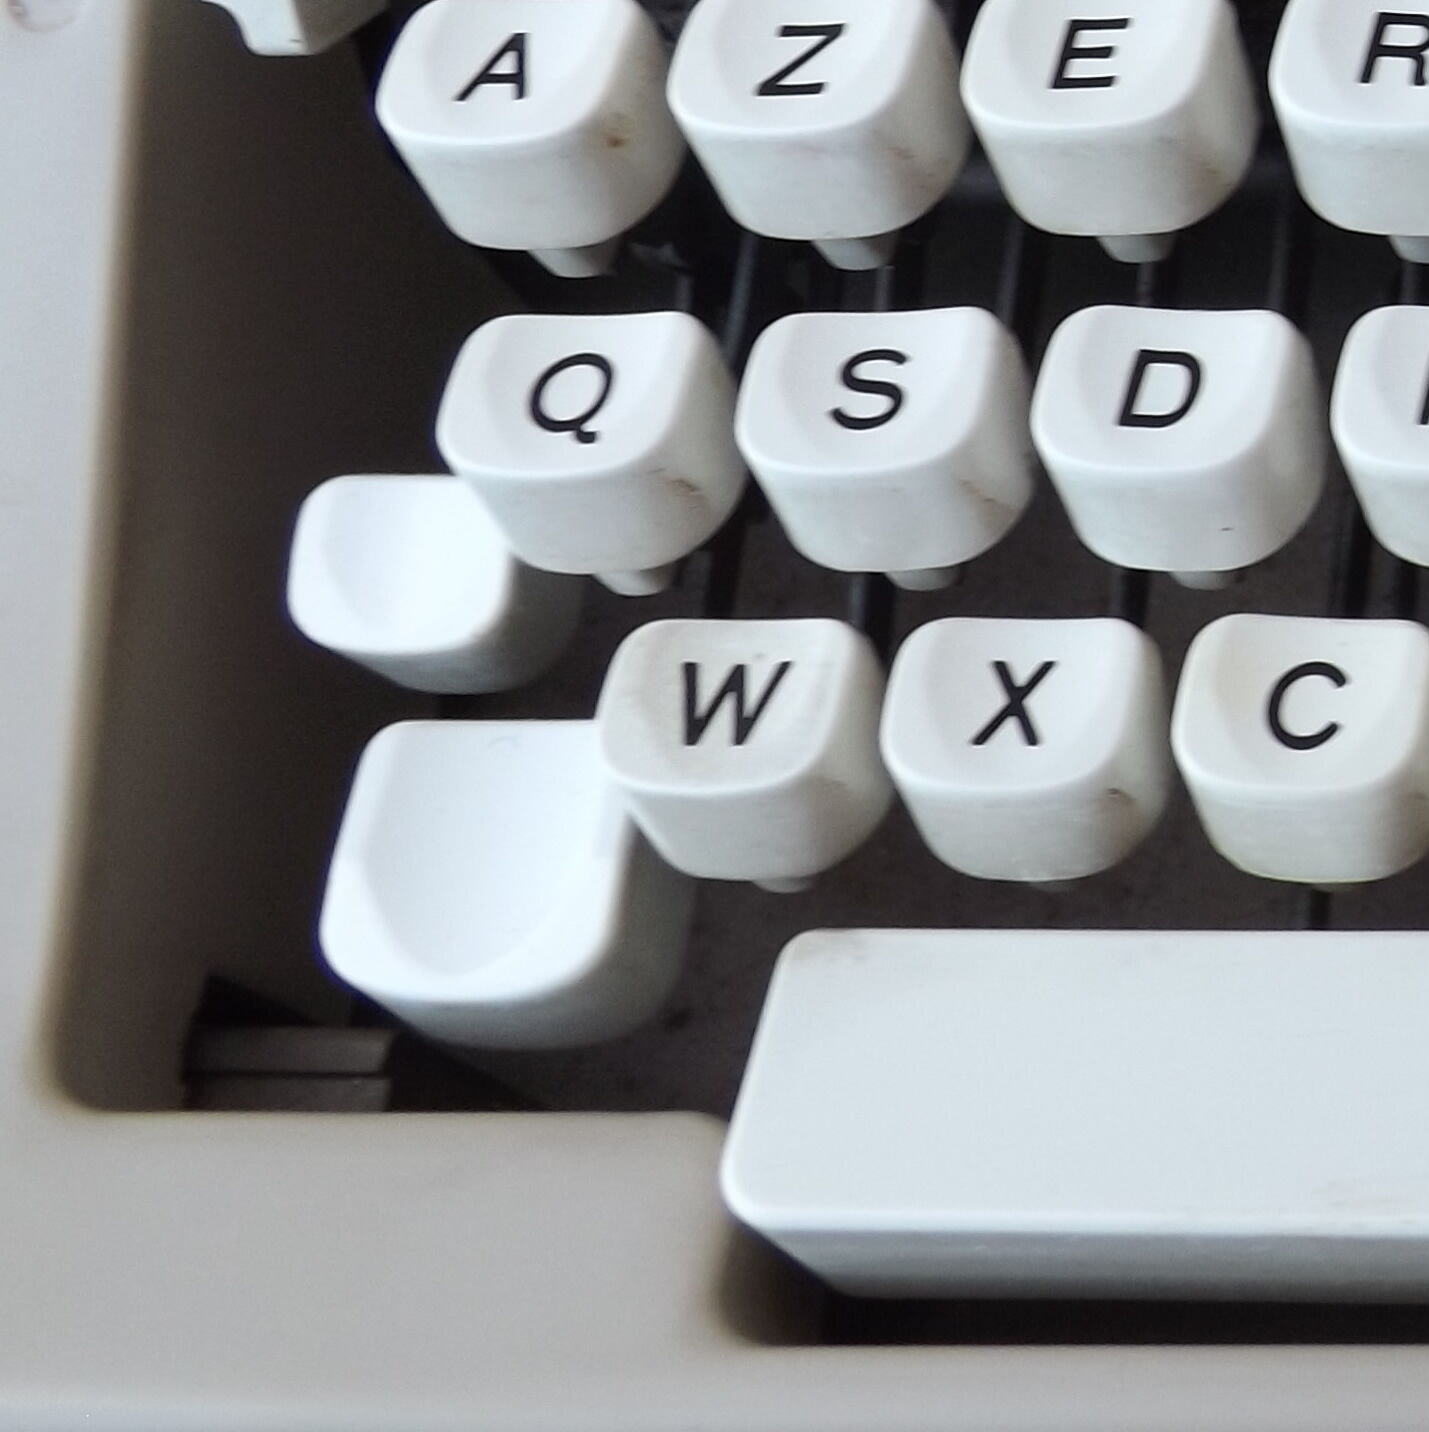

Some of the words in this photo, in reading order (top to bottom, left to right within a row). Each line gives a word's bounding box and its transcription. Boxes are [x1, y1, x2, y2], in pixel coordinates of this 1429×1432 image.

[454, 31, 528, 103] A
[754, 22, 846, 98] Z
[1048, 16, 1131, 91] E
[527, 351, 615, 446] Q
[828, 347, 909, 432] S
[1115, 347, 1204, 430] D
[680, 659, 793, 748] W
[970, 659, 1057, 748] X
[1264, 660, 1349, 752] C
